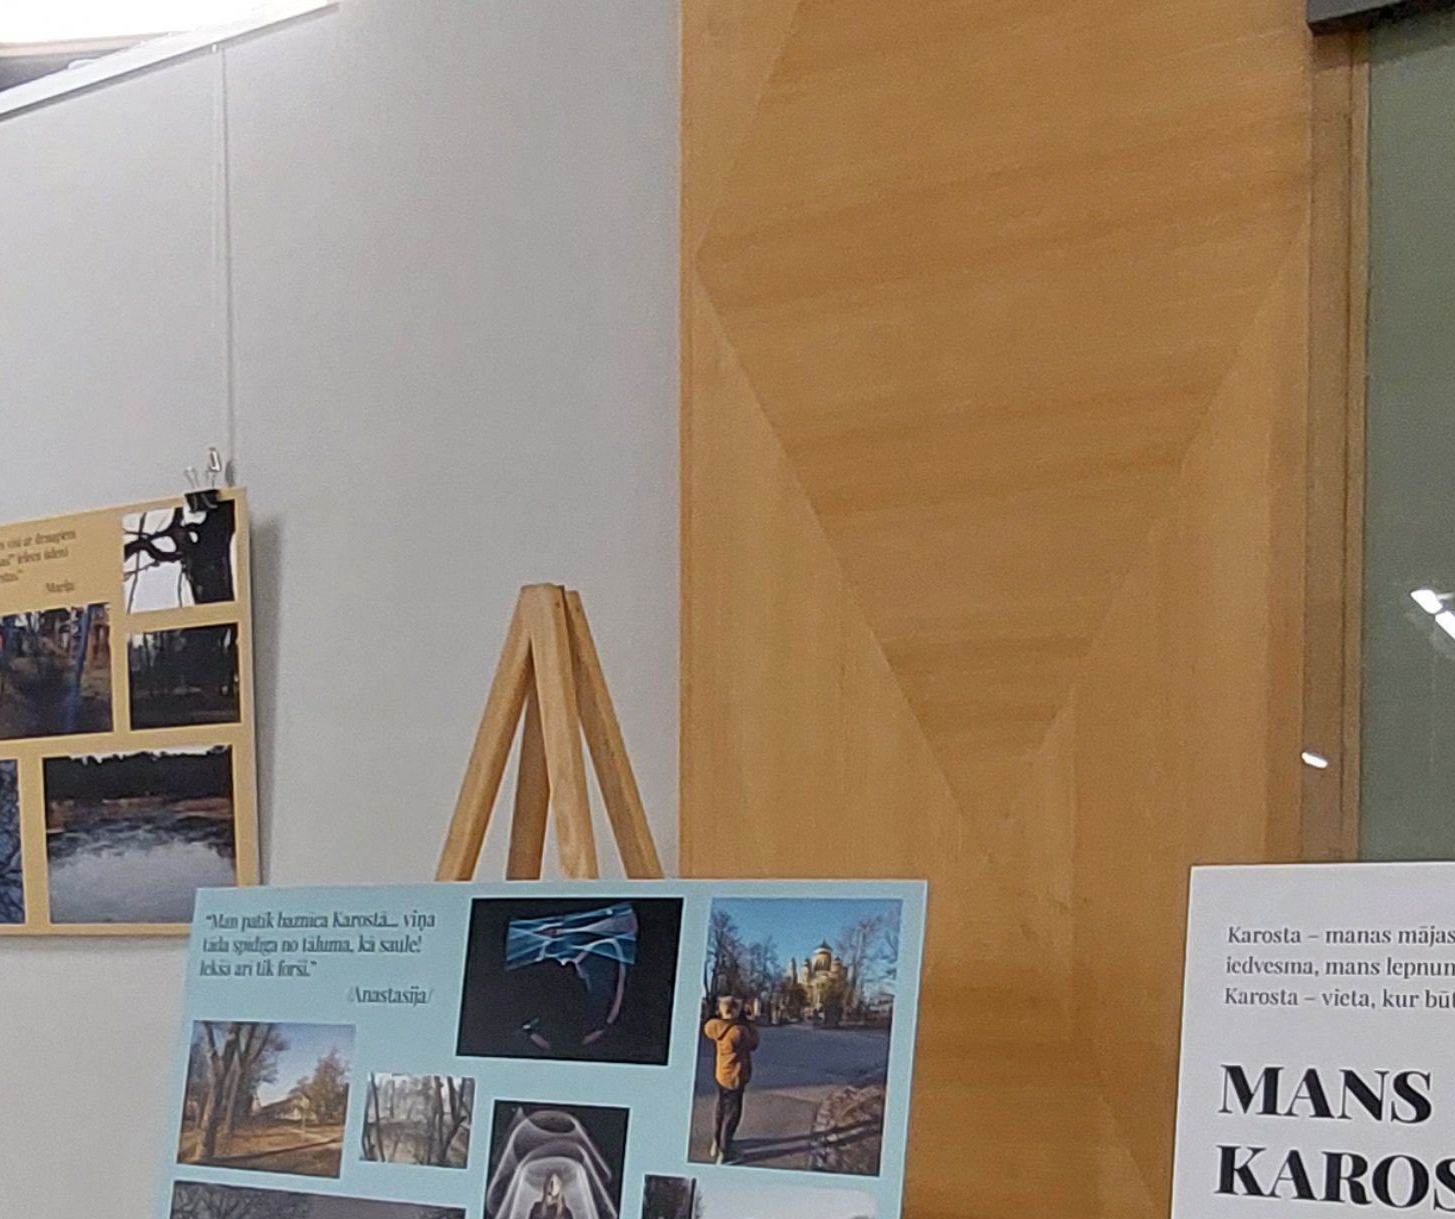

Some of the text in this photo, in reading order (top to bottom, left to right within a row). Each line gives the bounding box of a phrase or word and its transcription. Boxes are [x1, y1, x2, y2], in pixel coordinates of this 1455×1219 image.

[282, 939, 298, 953] no
[379, 935, 422, 953] saule!
[1228, 926, 1301, 944] Karosta
[1326, 929, 1391, 944] manas
[1226, 956, 1319, 977] iedvesma,
[1325, 960, 1380, 976] mans
[1225, 988, 1298, 1005] Karosta
[1322, 988, 1375, 1010] vieta,
[1382, 989, 1419, 1008] kur
[1218, 1064, 1433, 1124] MANS
